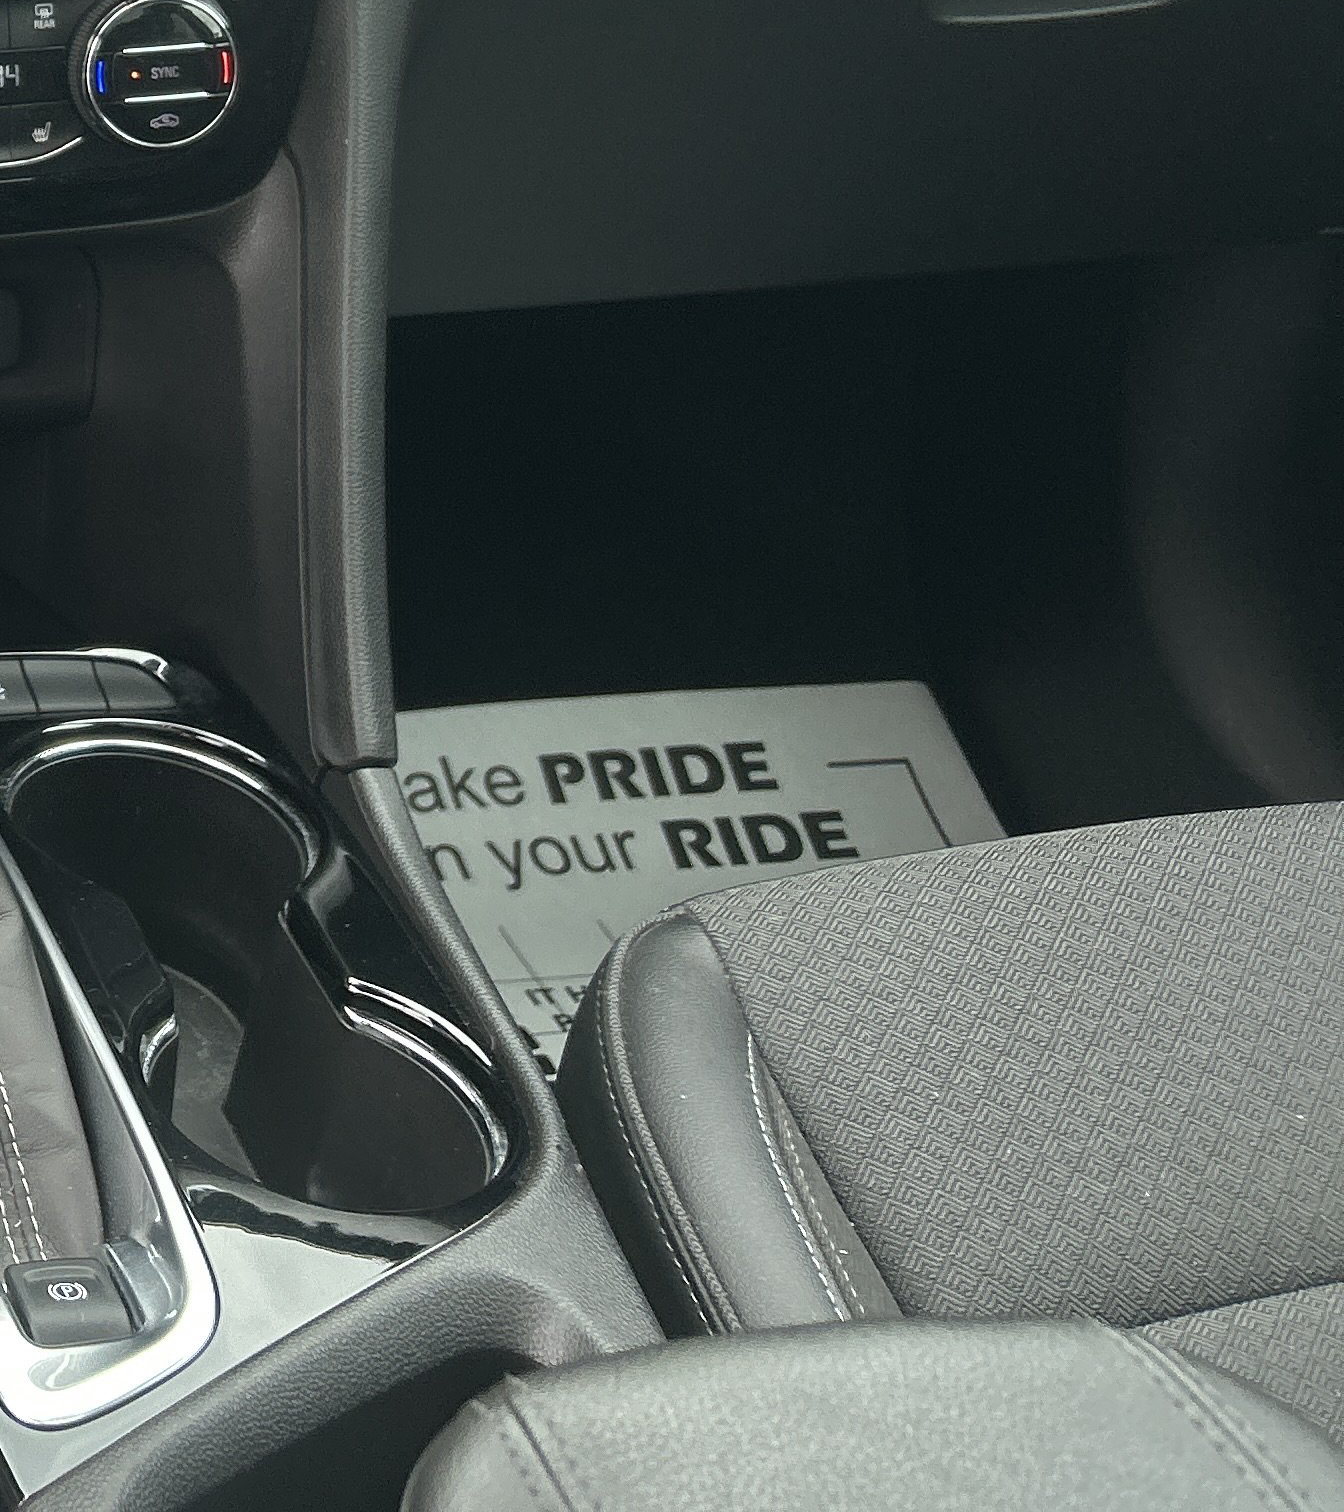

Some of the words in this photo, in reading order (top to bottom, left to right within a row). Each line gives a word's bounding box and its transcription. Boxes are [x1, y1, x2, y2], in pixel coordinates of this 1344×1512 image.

[33, 19, 55, 30] REAR
[150, 65, 180, 80] SYNC
[403, 755, 526, 813] ake
[537, 740, 779, 805] PRIDE
[422, 842, 473, 882] n
[484, 829, 635, 891] your
[659, 811, 861, 870] RIDE
